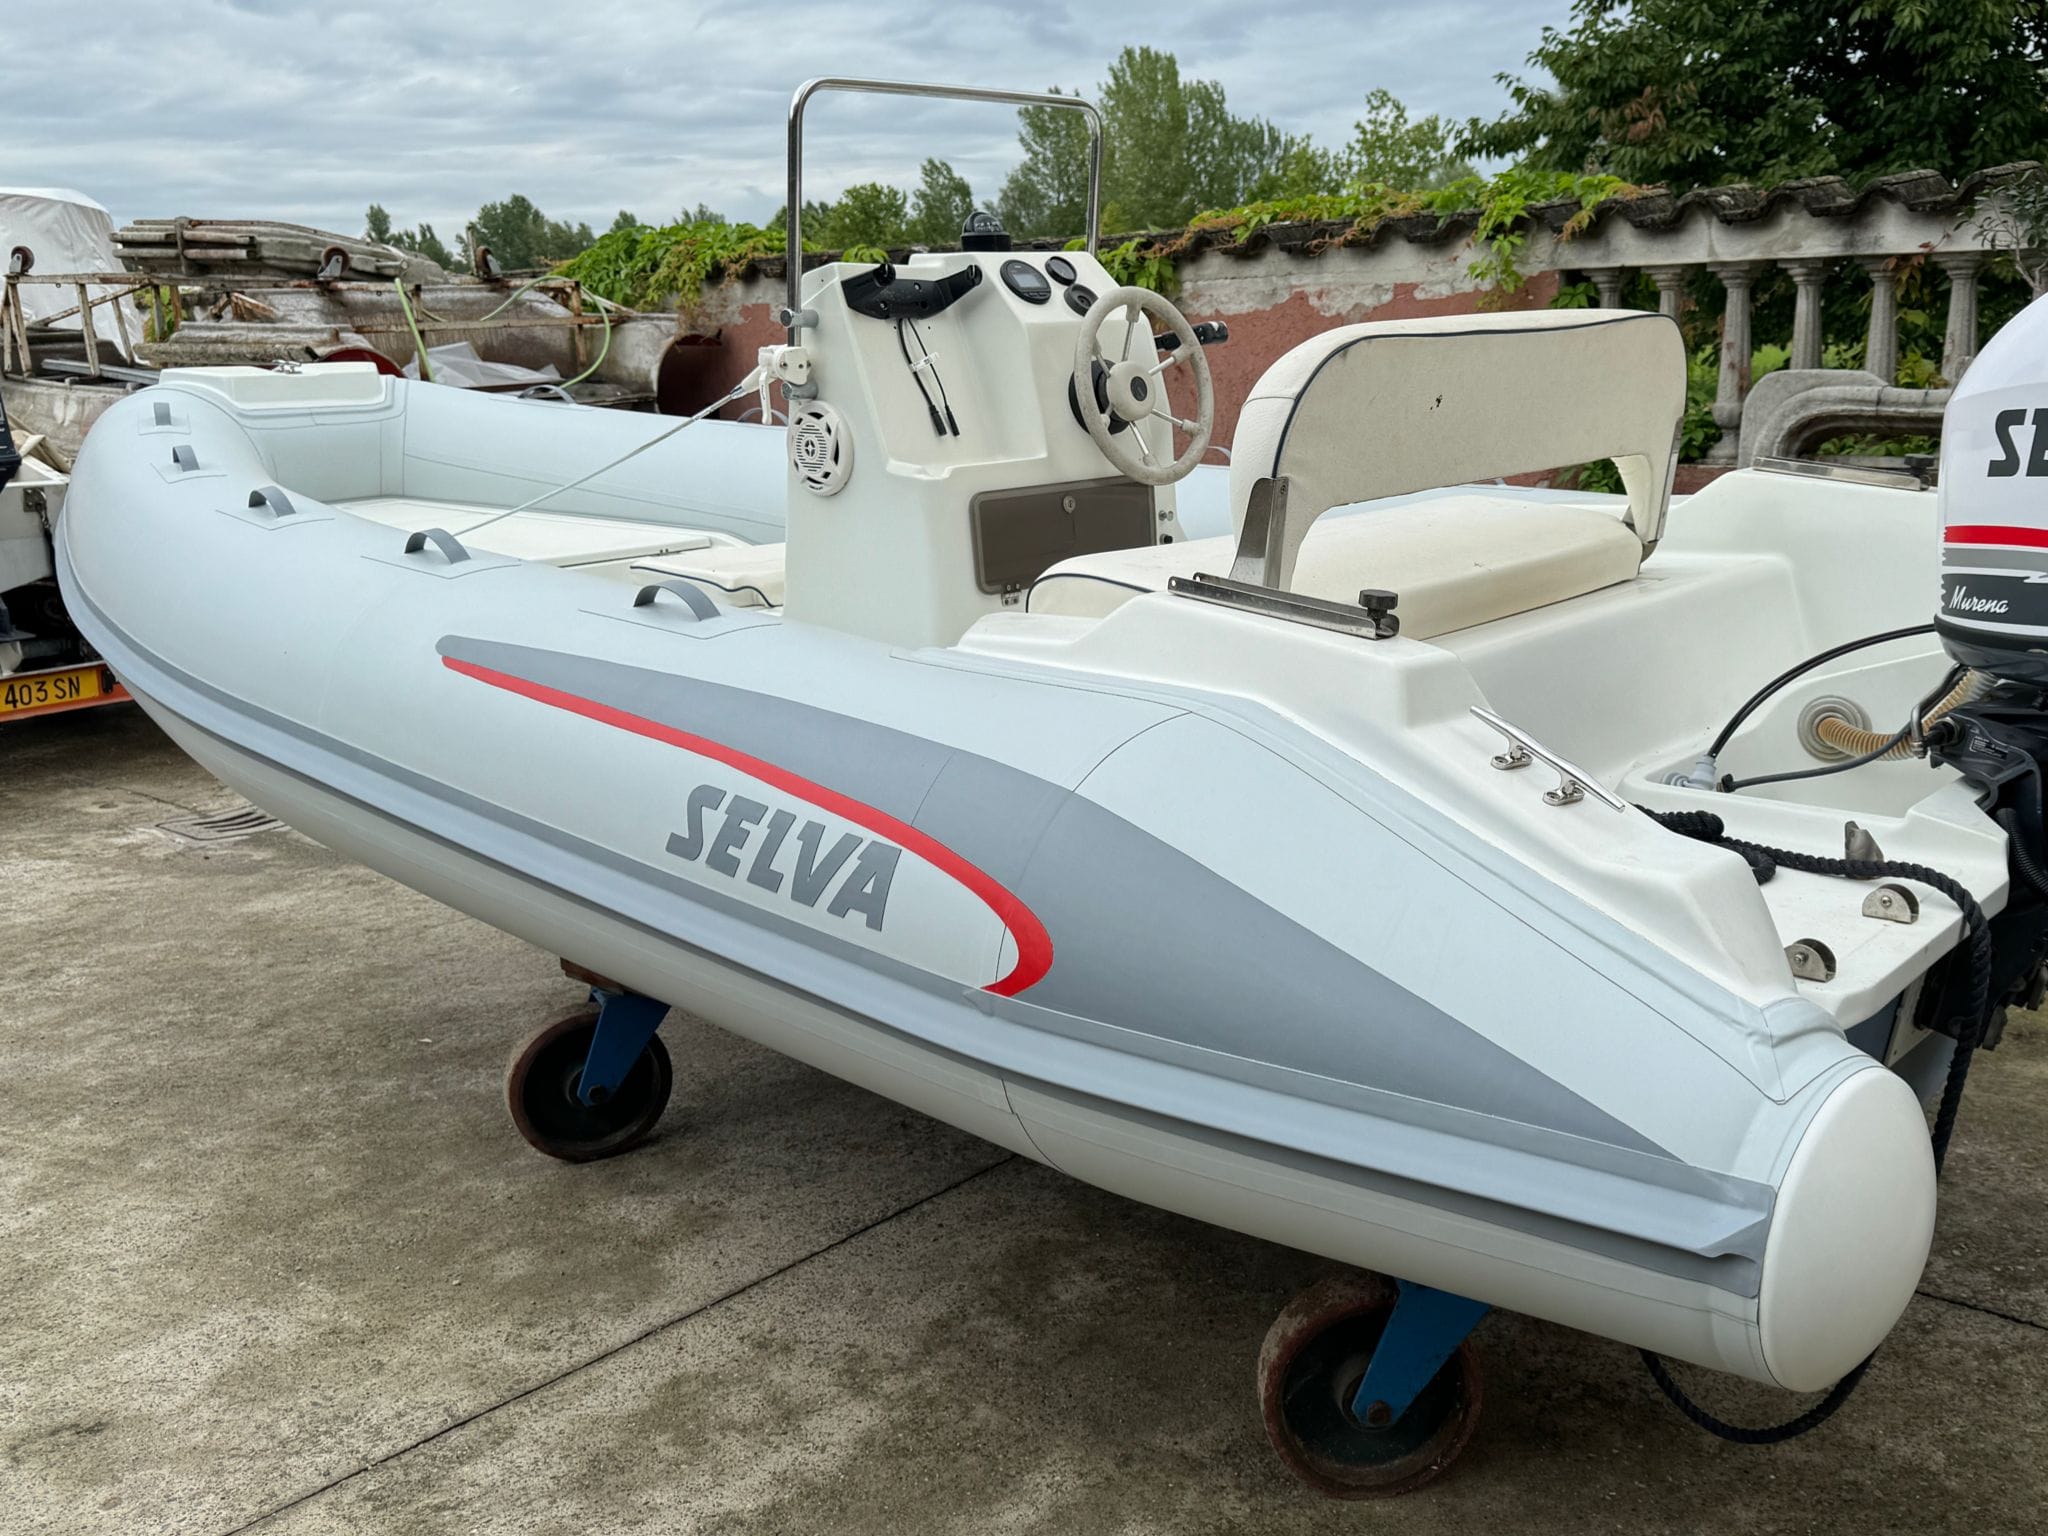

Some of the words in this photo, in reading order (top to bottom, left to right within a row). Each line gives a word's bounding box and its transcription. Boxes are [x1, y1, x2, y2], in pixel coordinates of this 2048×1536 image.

[1949, 585, 2009, 614] Murena
[5, 681, 48, 709] 403
[53, 676, 80, 699] SN
[665, 784, 902, 932] SELVA
